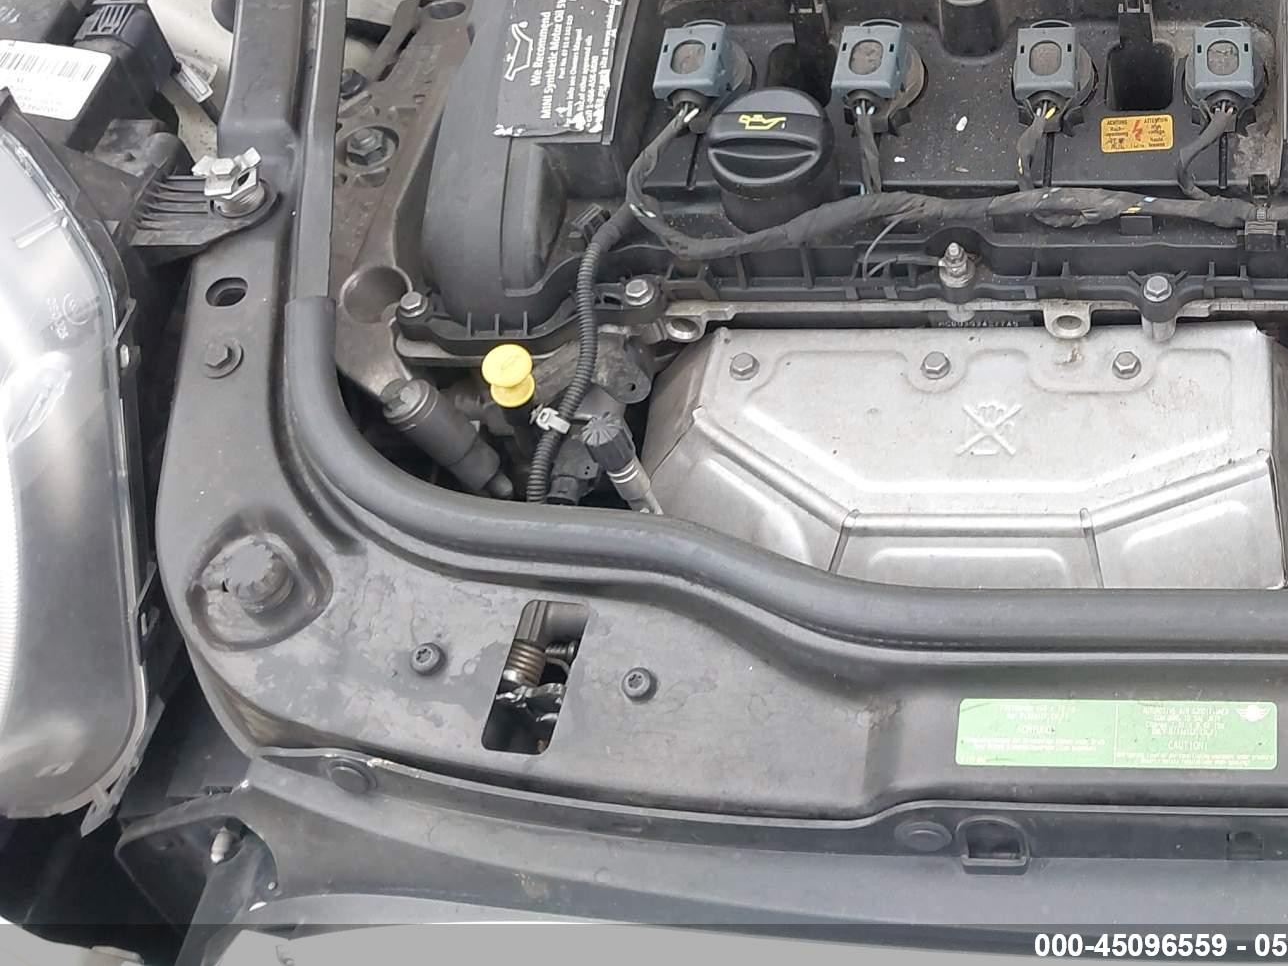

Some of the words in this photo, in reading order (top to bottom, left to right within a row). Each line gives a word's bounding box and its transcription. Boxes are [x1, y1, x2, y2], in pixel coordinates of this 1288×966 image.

[554, 9, 565, 23] Oil
[532, 11, 552, 68] Recommend
[549, 23, 563, 51] Motor
[529, 68, 543, 86] We
[543, 50, 559, 94] Synthetic
[540, 94, 553, 119] MINI
